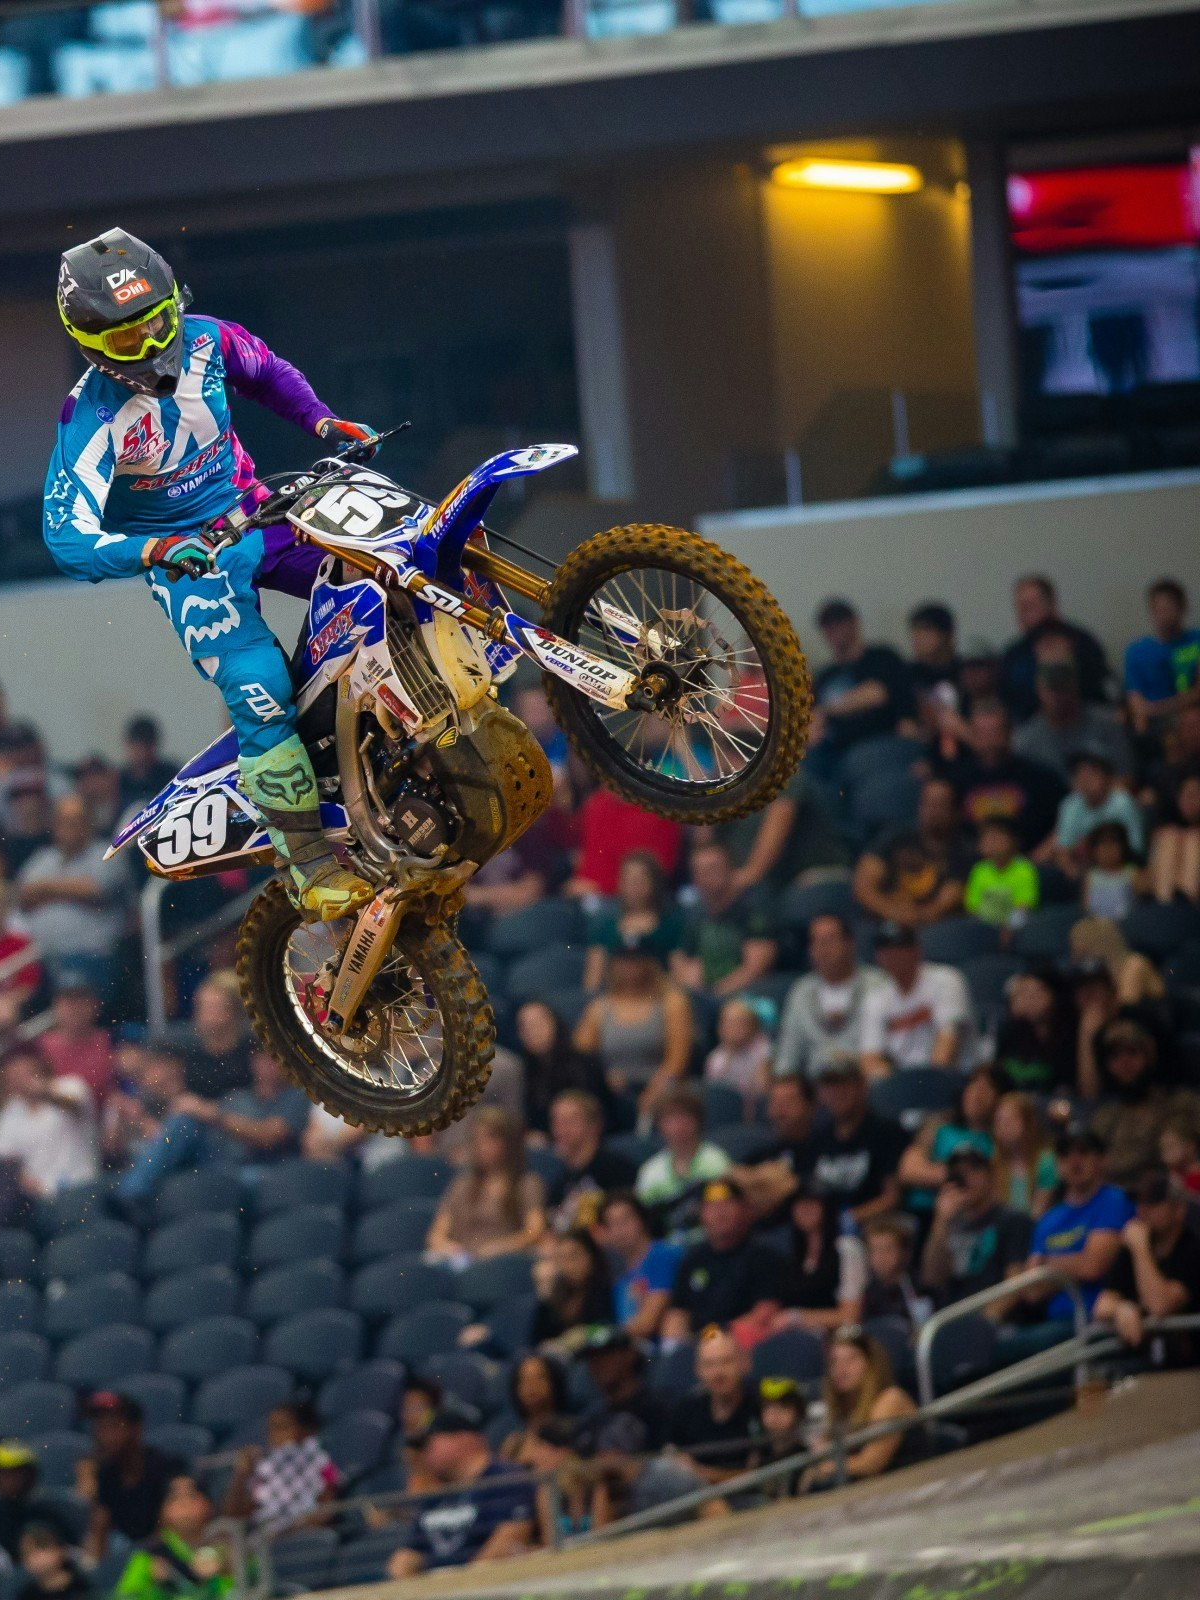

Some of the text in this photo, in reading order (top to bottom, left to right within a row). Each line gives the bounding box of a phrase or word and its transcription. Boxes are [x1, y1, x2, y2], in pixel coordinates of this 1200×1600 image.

[117, 411, 158, 461] 51
[181, 461, 222, 494] YAMAHA
[536, 640, 618, 680] DUNLOP
[544, 655, 577, 675] VERTEX
[239, 682, 287, 723] FOX
[157, 793, 228, 866] 59
[407, 817, 435, 846] HINSON
[347, 928, 377, 975] YAMAHA
